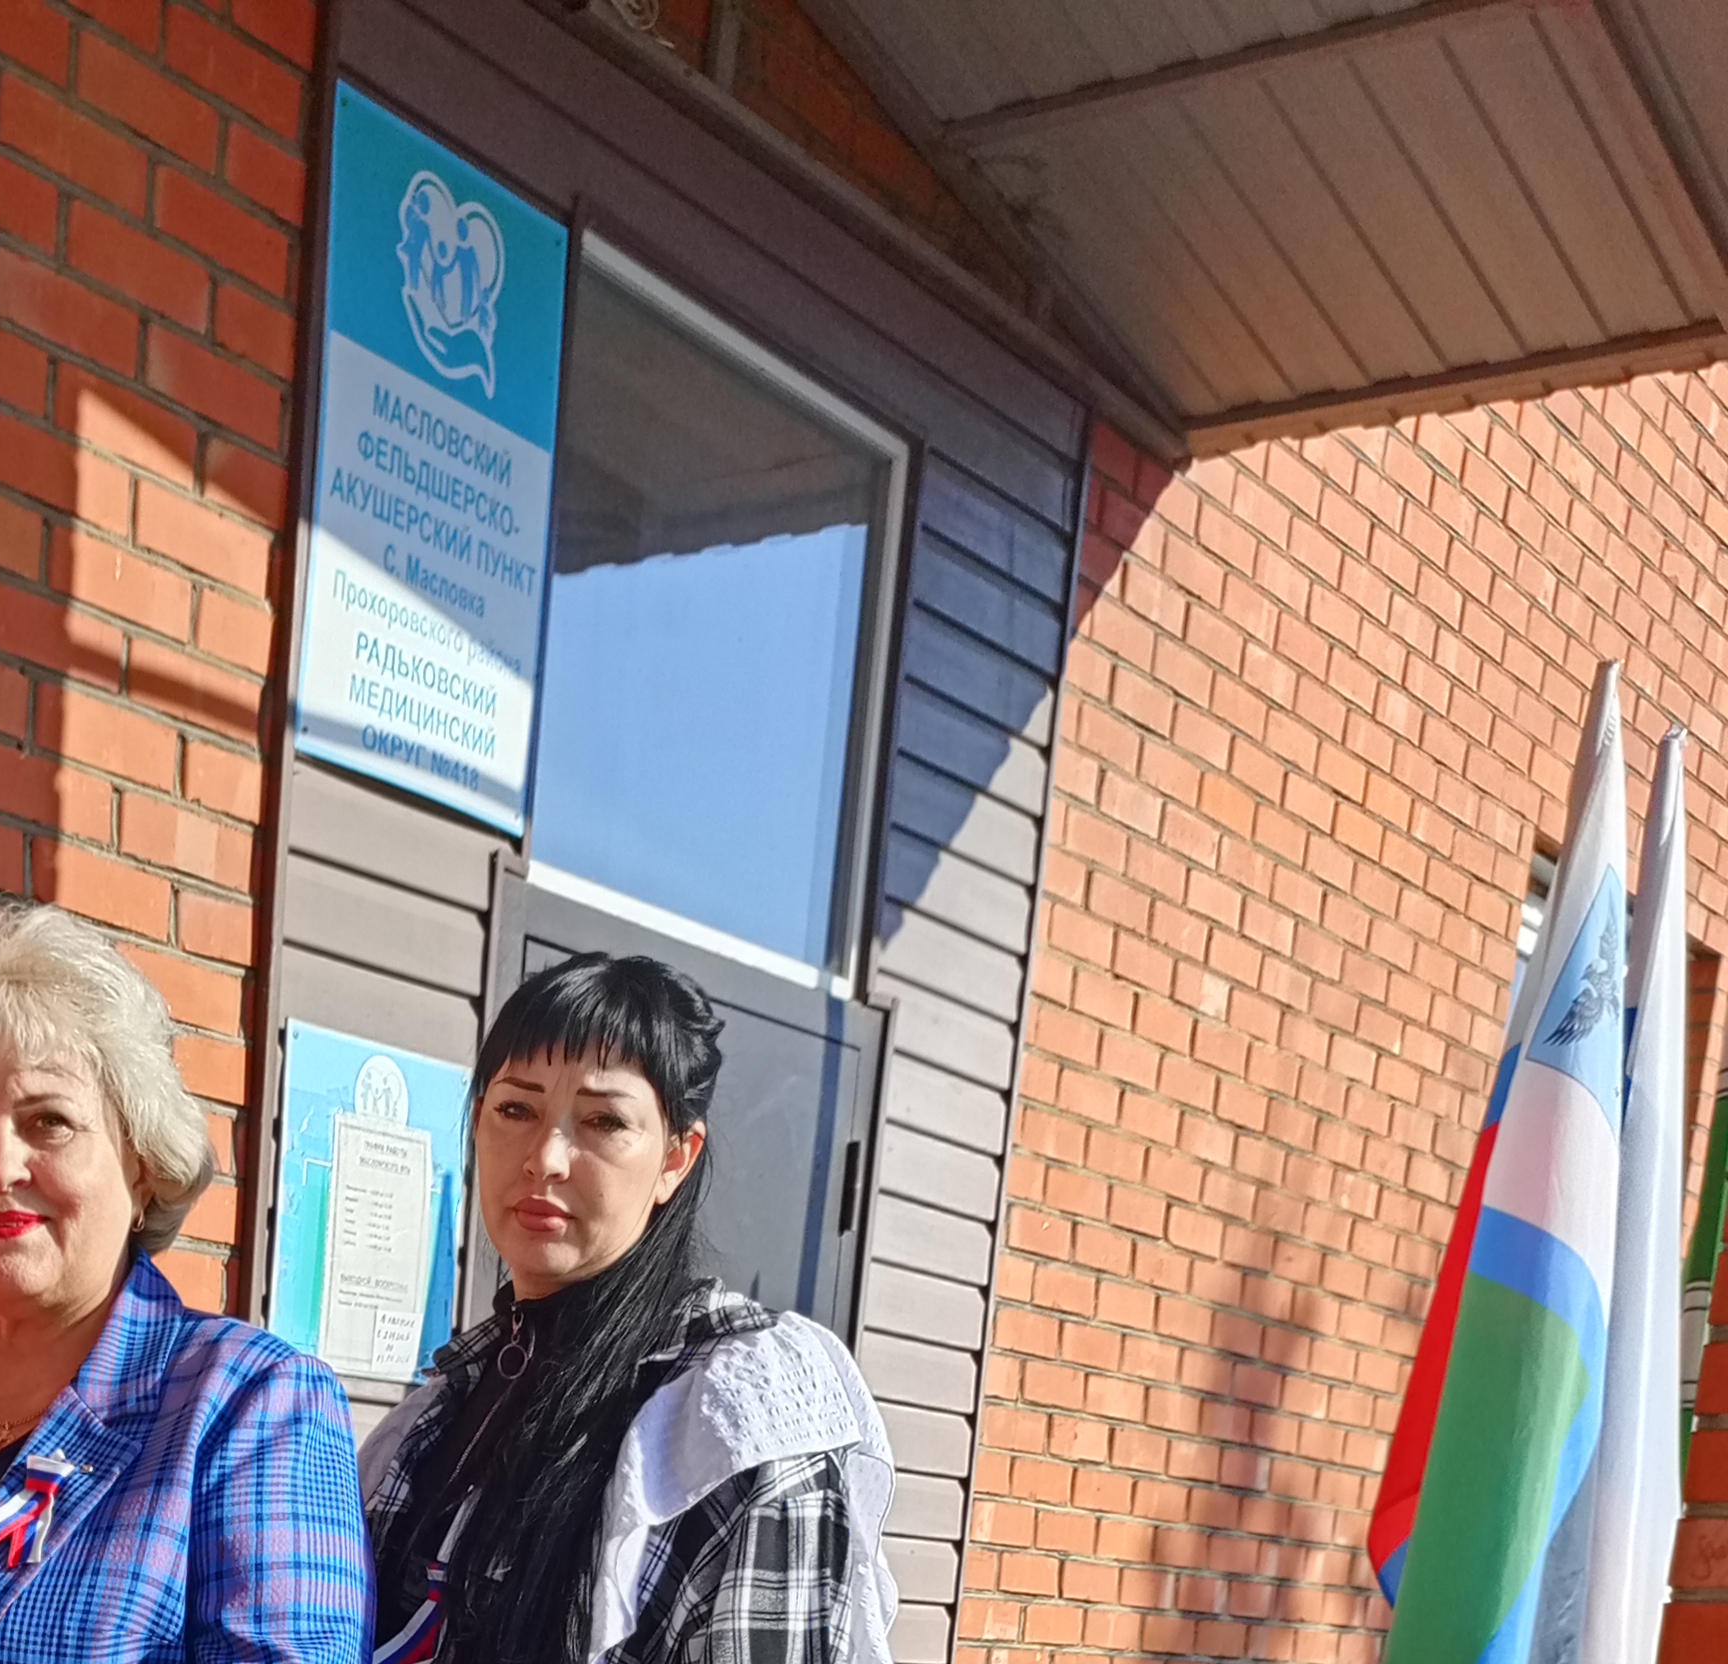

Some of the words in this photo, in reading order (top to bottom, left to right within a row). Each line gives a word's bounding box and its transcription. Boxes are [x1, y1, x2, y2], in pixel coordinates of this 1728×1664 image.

[373, 384, 512, 487] МАСЛОВСКИЙ
[358, 431, 520, 536] ФЕЛЬДШЕРСКО-
[330, 467, 472, 564] АКУШЕРСКИЙ
[477, 540, 537, 597] ПУНКТ
[333, 569, 463, 655] Прохоровского
[406, 554, 485, 618] Масловка
[349, 674, 497, 760] МЕДИЦИНСКИЙ
[355, 631, 498, 719] РАДЬКОВСКИЙ
[361, 723, 427, 767] ОКРУГ
